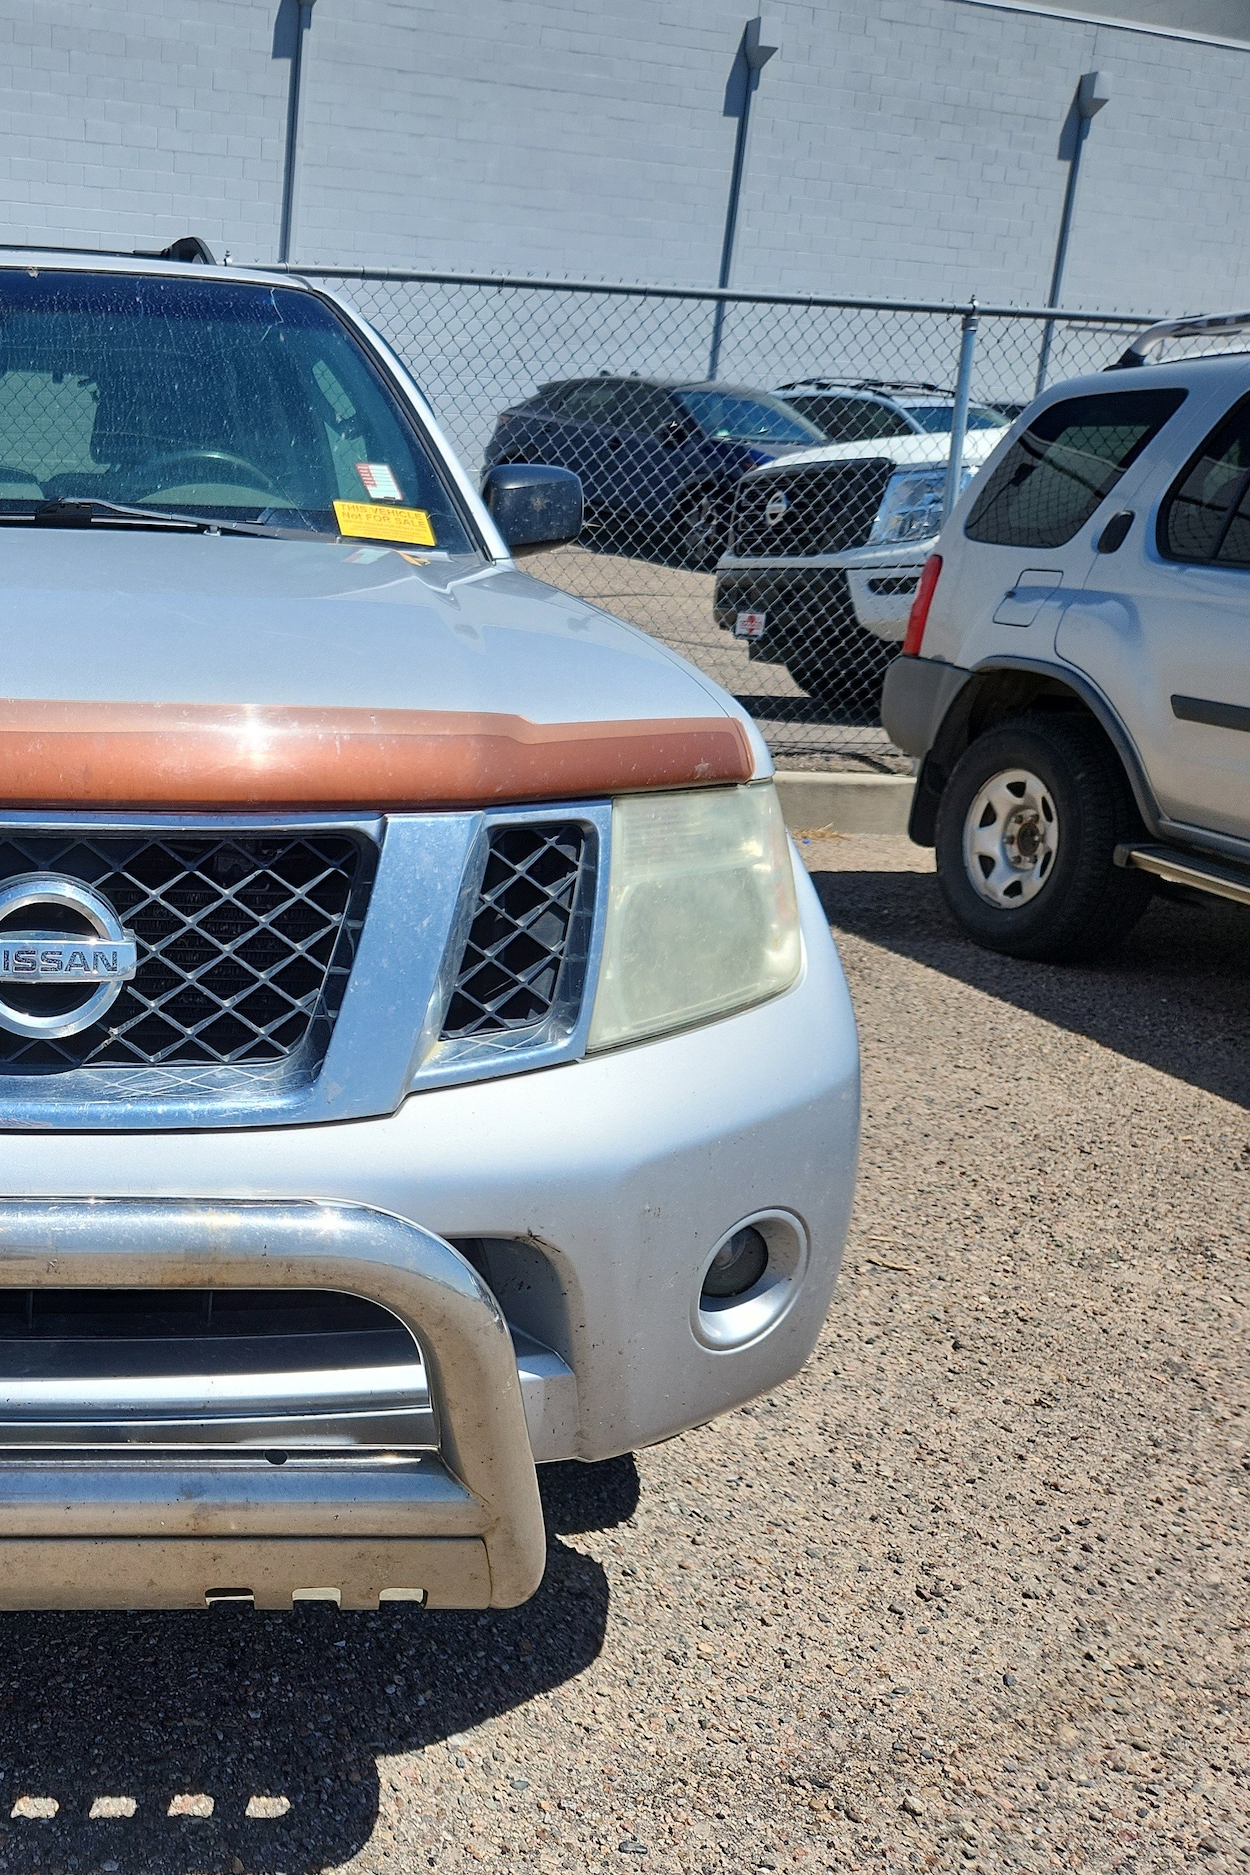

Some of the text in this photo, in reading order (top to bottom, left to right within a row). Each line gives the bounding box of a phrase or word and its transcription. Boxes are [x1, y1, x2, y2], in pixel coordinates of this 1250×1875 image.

[341, 504, 422, 520] THIS VEHICLE
[342, 512, 362, 520] Not
[366, 514, 392, 523] FOR
[395, 518, 426, 528] SALE
